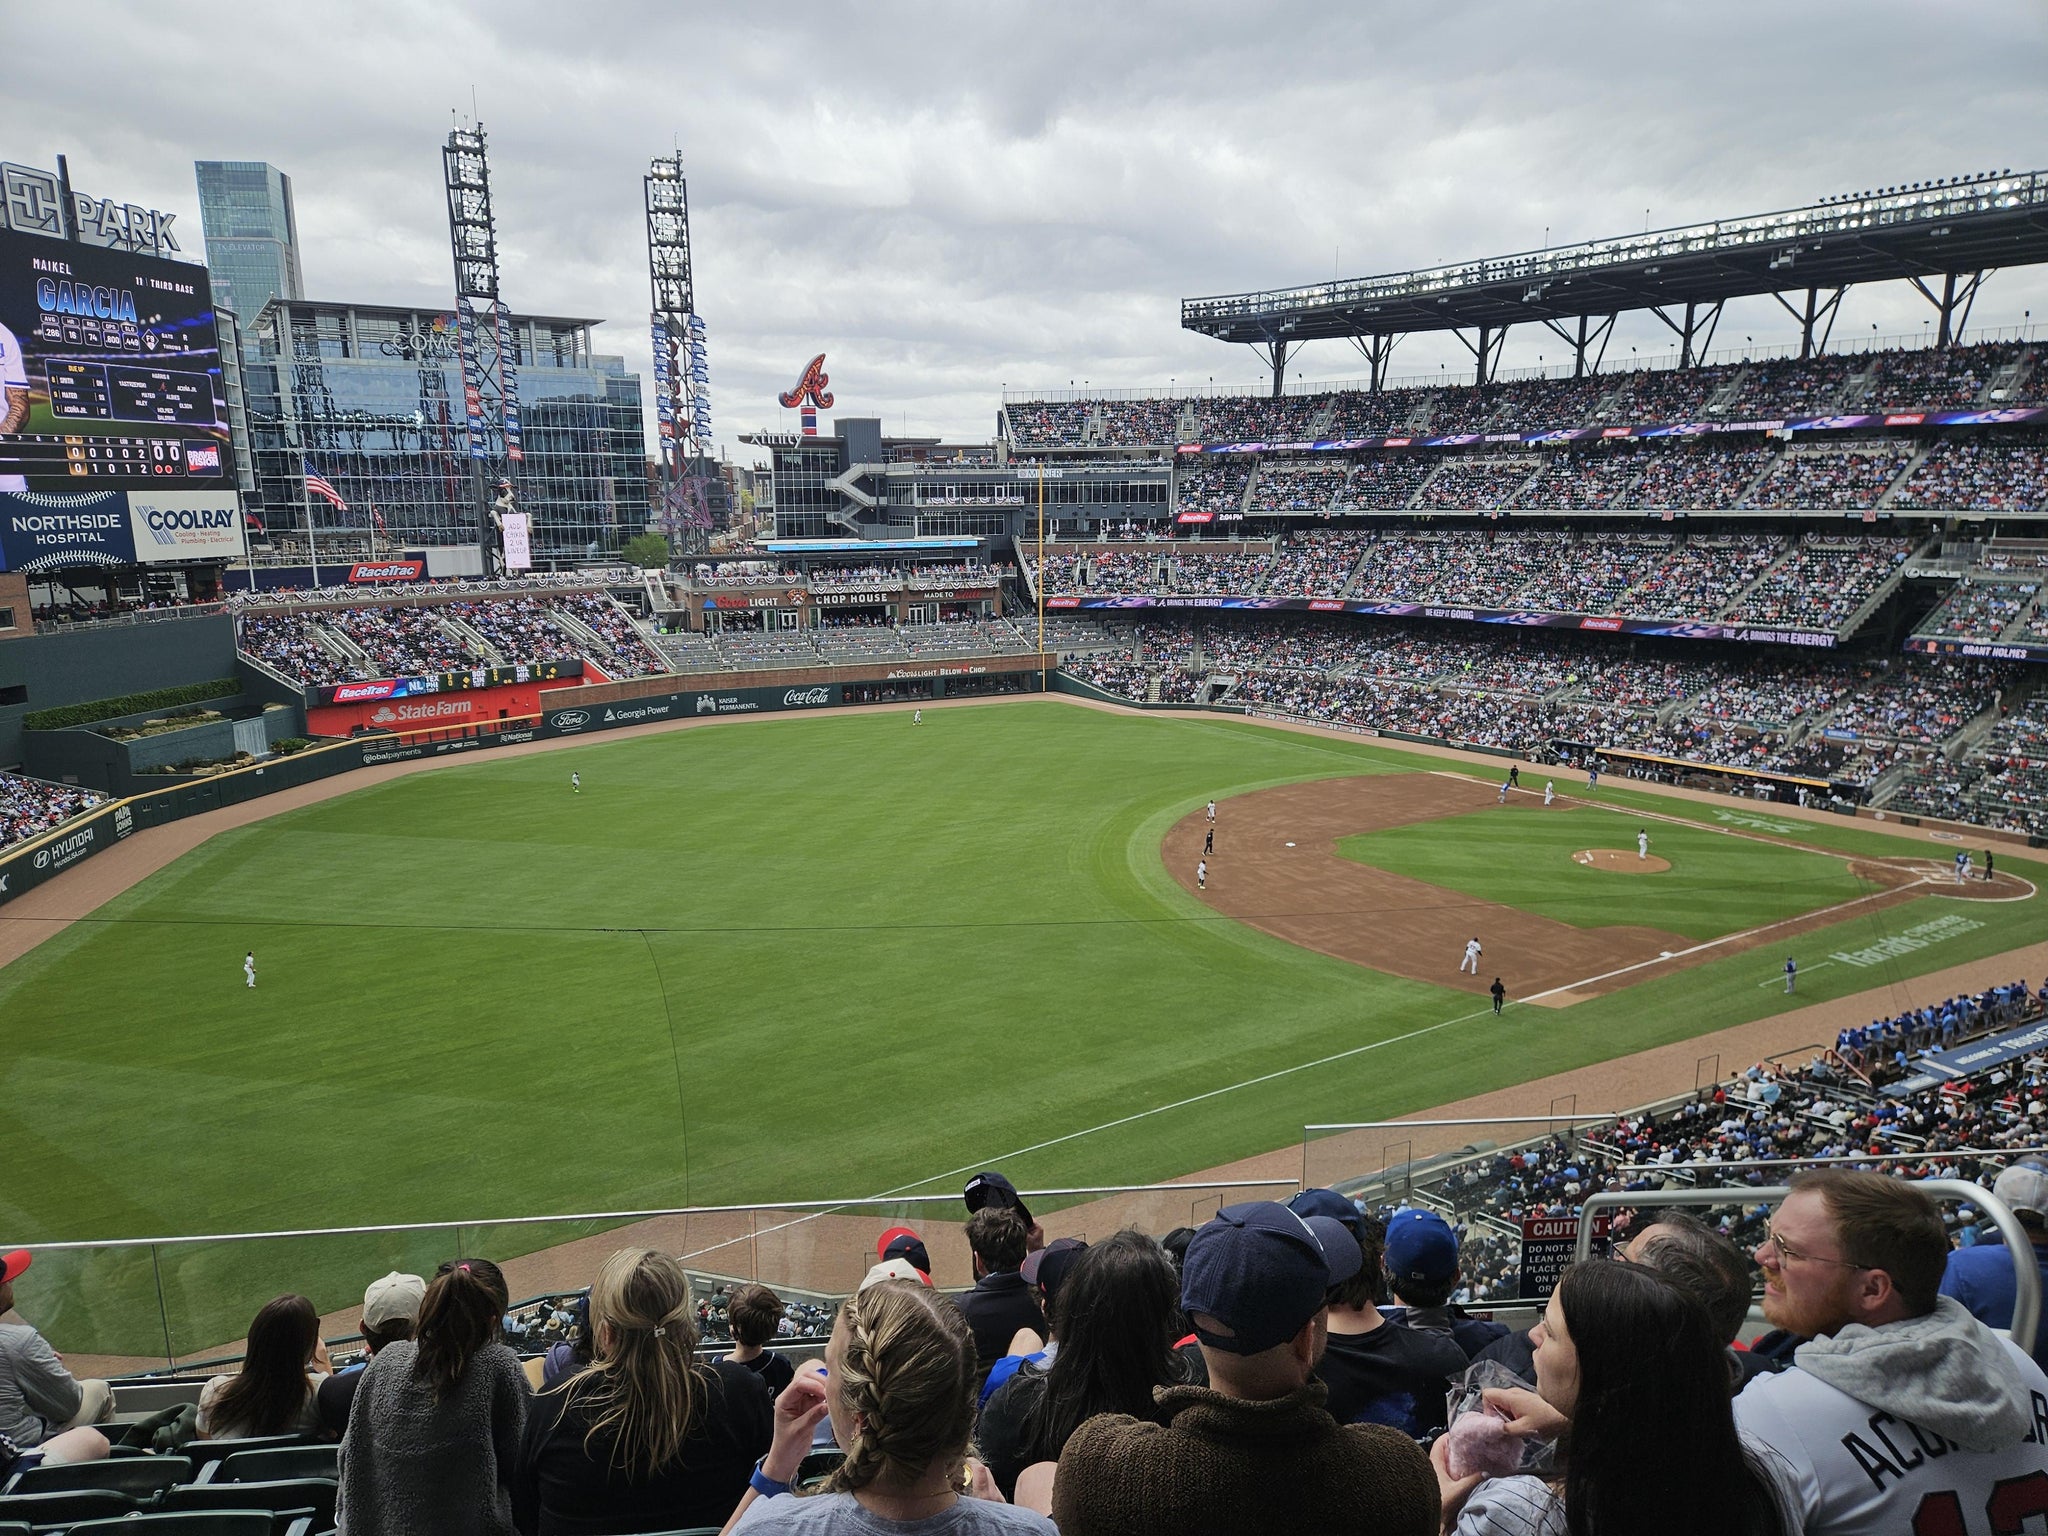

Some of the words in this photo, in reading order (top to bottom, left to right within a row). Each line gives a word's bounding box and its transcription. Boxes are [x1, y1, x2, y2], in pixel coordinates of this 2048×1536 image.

[72, 190, 181, 251] PARK
[33, 258, 72, 275] MAIKEL
[135, 276, 143, 286] 11
[150, 279, 173, 292] THIRD
[175, 283, 194, 295] BASE
[36, 277, 138, 323] GARCIA
[88, 333, 98, 342] 74
[749, 427, 803, 449] xfinity
[72, 447, 79, 457] 0
[89, 447, 96, 458] 0
[106, 448, 113, 459] 0
[122, 448, 129, 459] 0
[138, 449, 145, 459] 2
[153, 446, 164, 461] 0
[170, 446, 180, 461] 0
[186, 450, 218, 460] BRAVES
[74, 463, 82, 473] 0
[92, 463, 99, 473] 1
[108, 463, 116, 473] 0
[125, 463, 131, 474] 1
[140, 463, 148, 474] 2
[188, 458, 219, 467] VISION
[1028, 470, 1061, 478] MINER
[12, 514, 122, 532] NORTHSIDE
[149, 509, 234, 531] COOLRAY
[1232, 513, 1243, 521] PM
[36, 532, 106, 545] HOSPITAL
[181, 537, 206, 545] Plumbing
[355, 565, 415, 578] RaceTrac
[815, 594, 846, 605] CHOP
[850, 593, 888, 604] HOUSE
[924, 591, 944, 599] MADE
[749, 597, 779, 607] LIGHT
[1194, 598, 1223, 607] ENERGY
[1425, 608, 1434, 616] WE
[1433, 608, 1445, 617] KEEP
[1450, 610, 1474, 620] GOING
[1722, 628, 1736, 640] THE
[1750, 631, 1776, 642] BRINGS
[1776, 631, 1790, 643] THE
[1790, 632, 1835, 648] ENERGY
[1962, 644, 1992, 657] GRANT
[1992, 646, 2028, 659] HOLMES
[916, 669, 937, 677] LIGHT
[940, 668, 962, 676] BELOW
[969, 666, 986, 674] CHOP
[339, 686, 390, 699] RaceTrac
[408, 681, 424, 691] NL
[783, 687, 831, 706] Coca-Cola
[557, 712, 583, 726] Ford
[616, 708, 646, 720] Georgia
[647, 705, 670, 715] Power
[507, 731, 533, 741] National
[363, 748, 422, 764] globalpayments
[114, 806, 131, 823] PAPA
[116, 816, 133, 833] JOHNS
[51, 827, 94, 860] HYUNDAI
[1533, 1220, 1600, 1236] CAUTIN
[1528, 1245, 1542, 1254] DO
[1545, 1244, 1564, 1253] NOT
[1529, 1255, 1554, 1264] LEAN
[1556, 1254, 1575, 1262] OVE
[1526, 1264, 1557, 1274] PLACE
[1535, 1275, 1549, 1283] ON
[1538, 1285, 1552, 1293] OR
